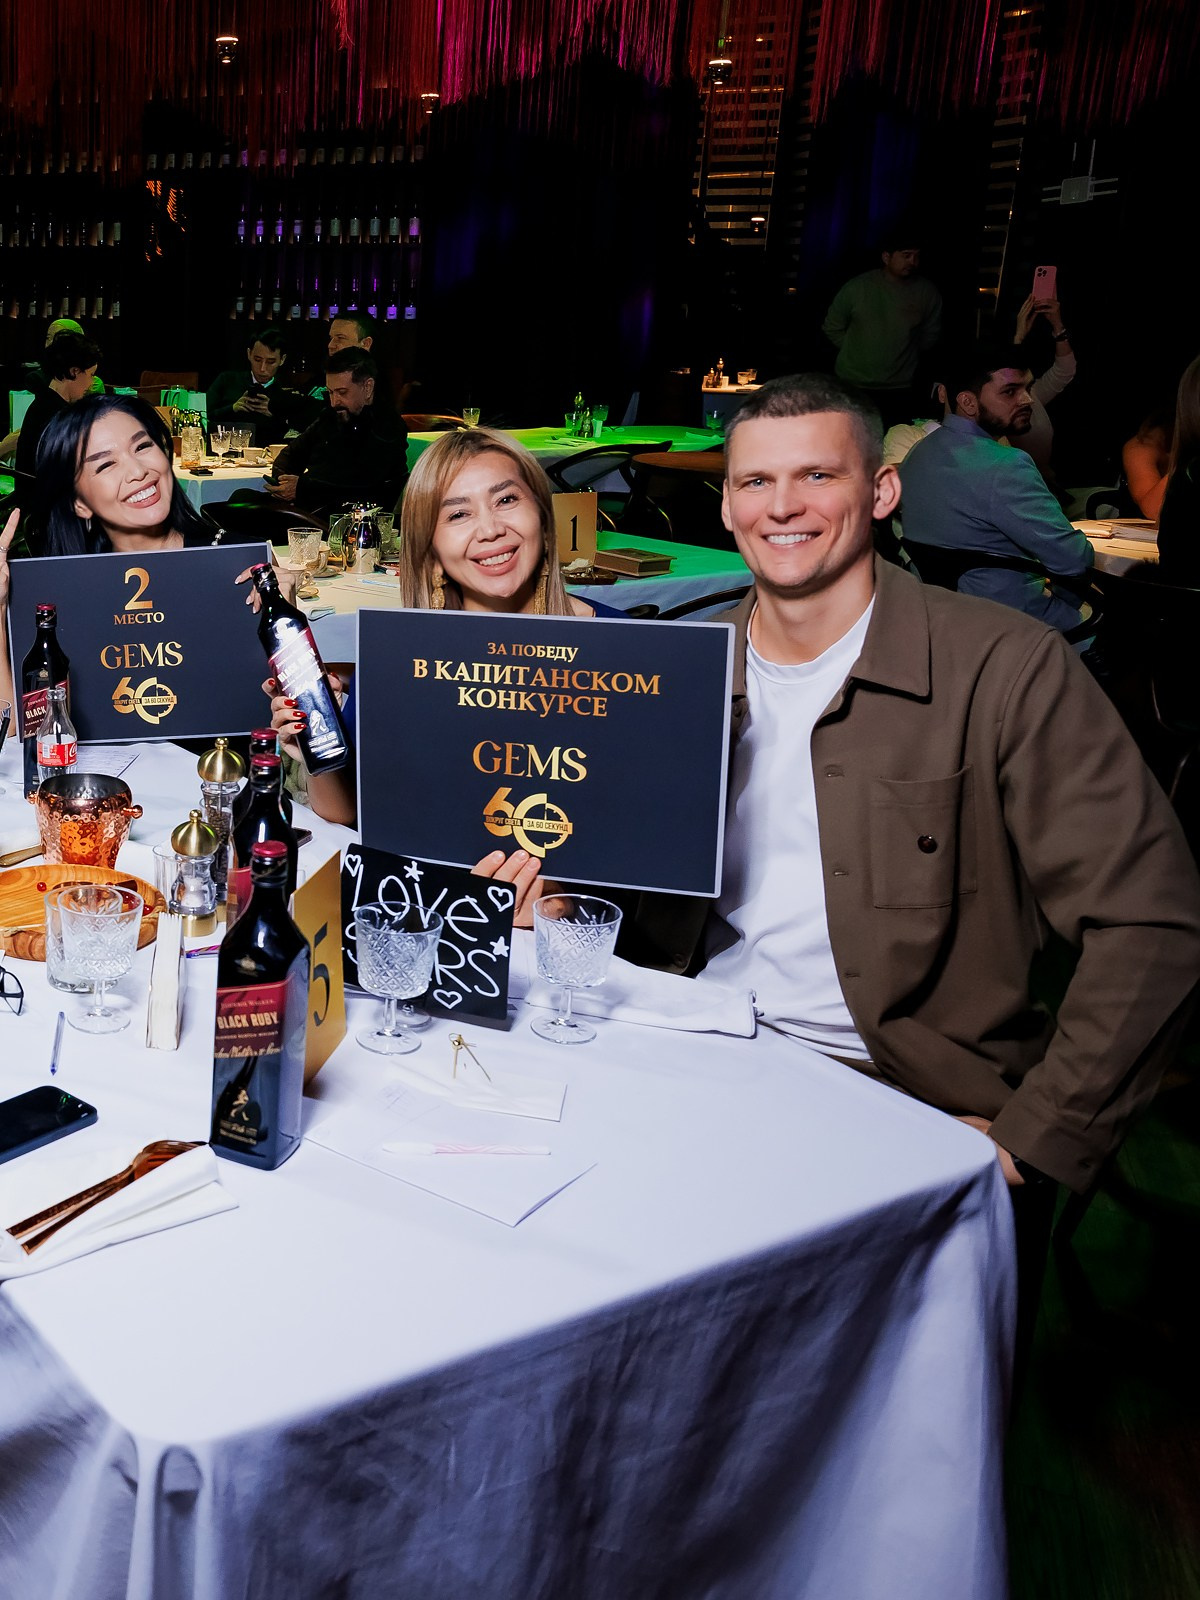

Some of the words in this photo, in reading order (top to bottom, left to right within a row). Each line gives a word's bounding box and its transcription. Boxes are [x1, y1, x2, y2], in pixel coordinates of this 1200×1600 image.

[570, 515, 578, 551] 1
[124, 567, 153, 610] 2
[113, 611, 165, 625] МЕСТО
[100, 641, 183, 669] GEMS
[487, 642, 507, 656] ЗА
[511, 644, 579, 662] ПОБЕДУ
[413, 659, 428, 678] В
[434, 660, 661, 695] КАПИТАНСКОМ
[25, 705, 47, 719] BLACK
[458, 687, 608, 718] КОНКУРСЕ
[472, 740, 587, 782] GEMS
[527, 820, 534, 828] ЗА
[536, 821, 543, 829] 60
[545, 822, 568, 832] СЕКУНД
[313, 921, 330, 1027] 5
[217, 1013, 249, 1029] BLACK
[250, 1011, 279, 1027] RUBY
